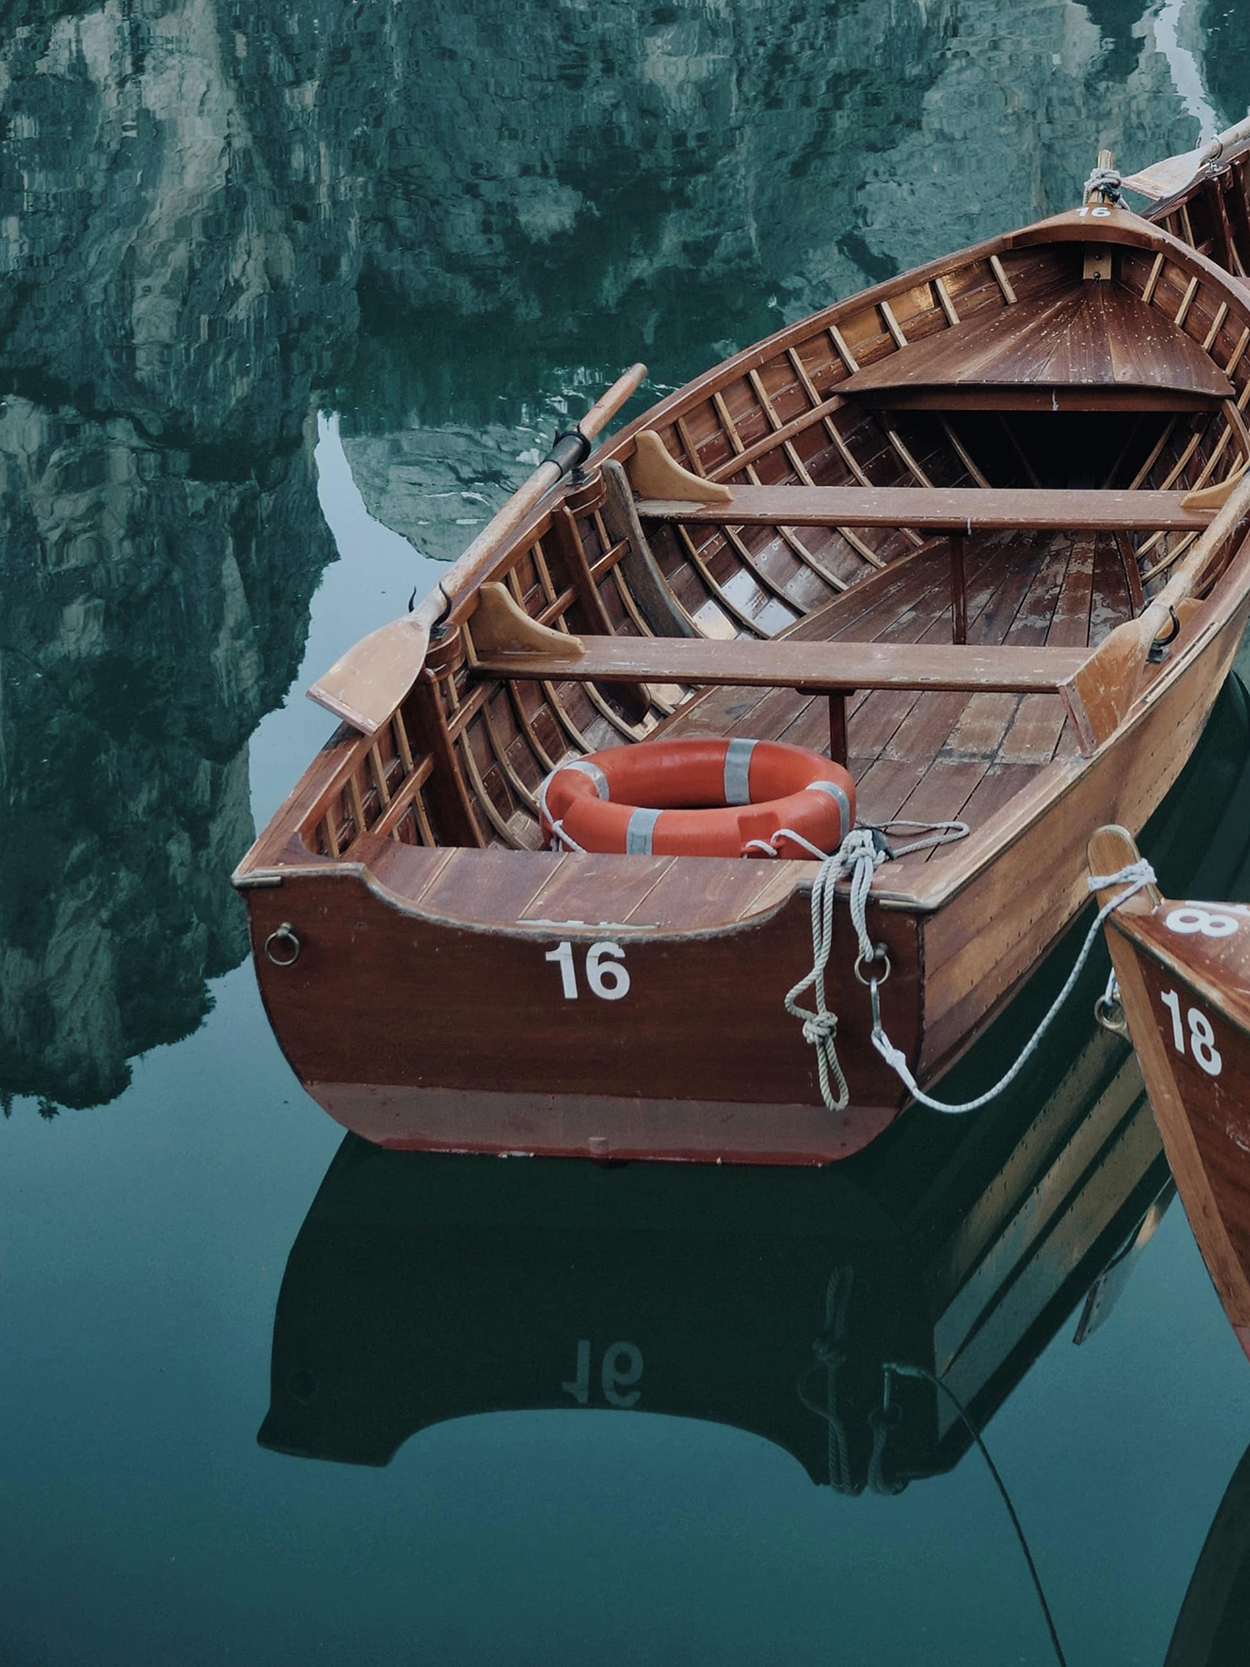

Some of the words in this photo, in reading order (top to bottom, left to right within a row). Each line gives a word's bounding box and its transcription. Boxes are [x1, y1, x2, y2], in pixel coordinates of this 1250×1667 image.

[1076, 206, 1111, 217] 16
[545, 941, 630, 1001] 16
[1160, 989, 1222, 1076] 18
